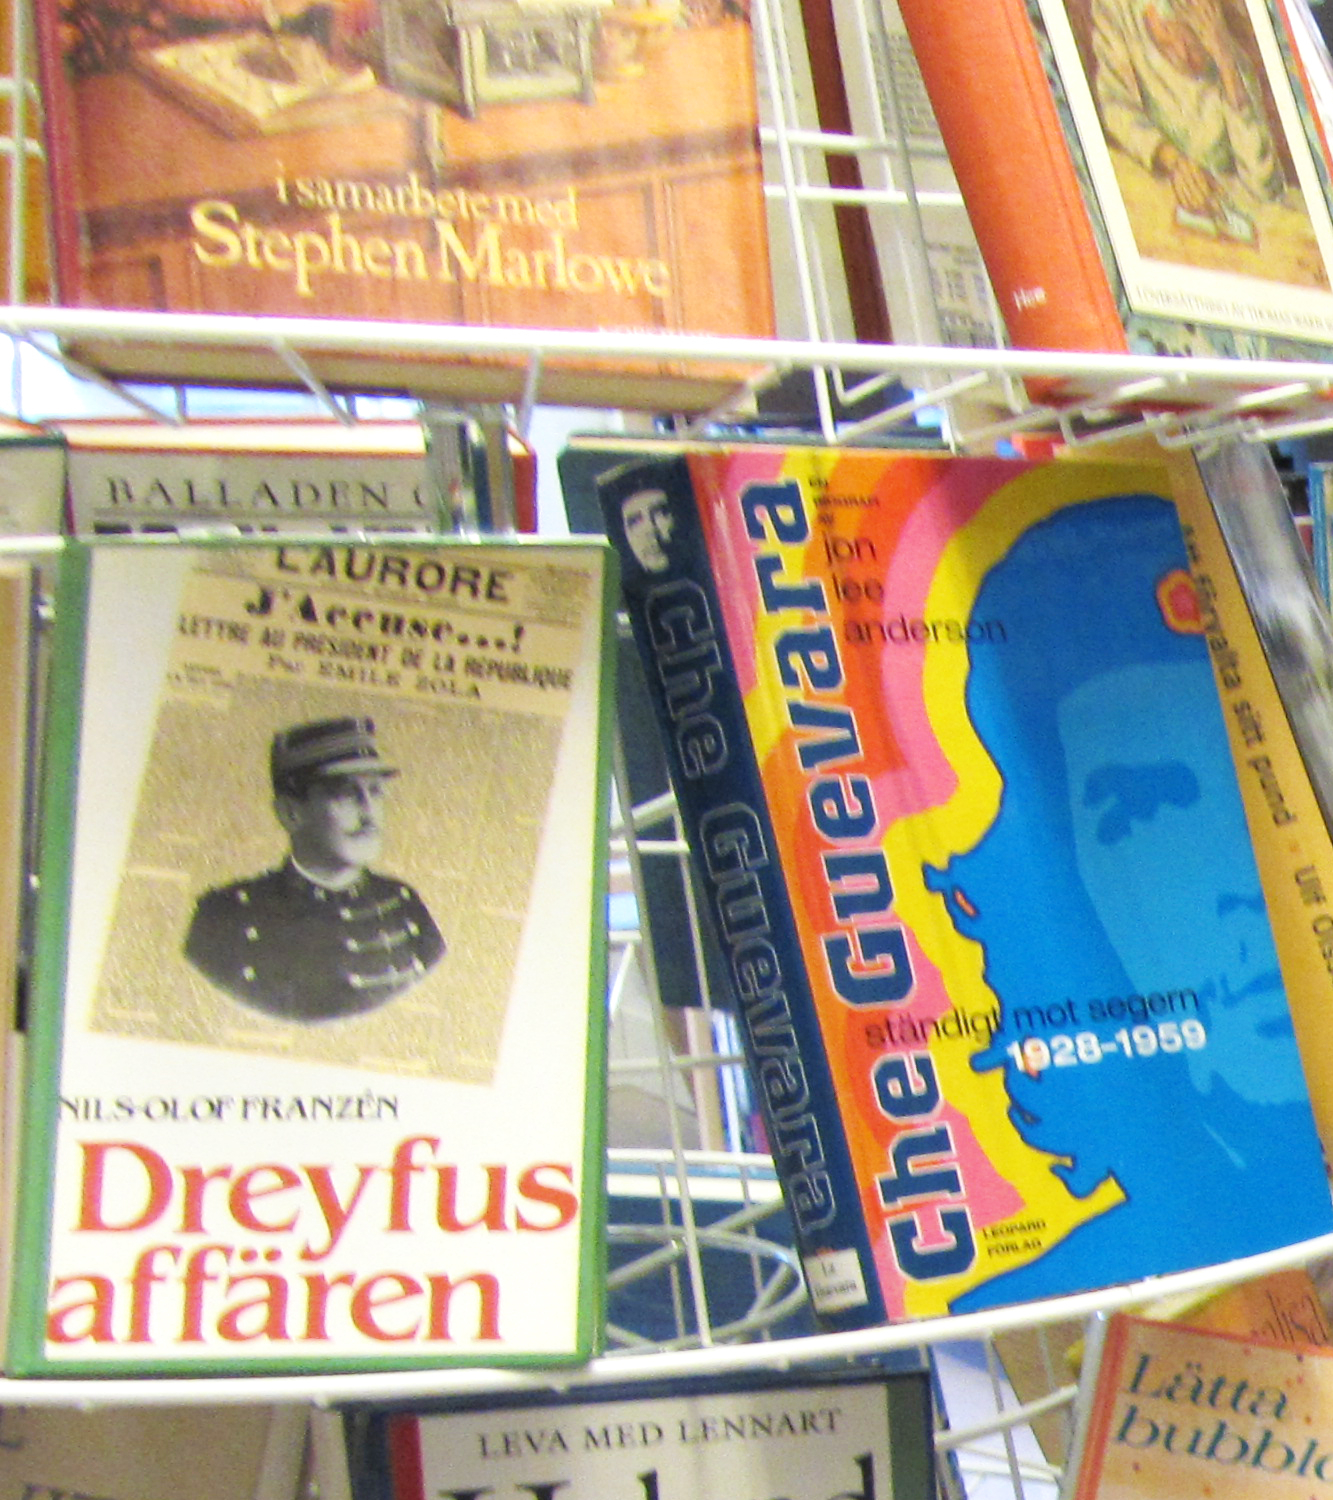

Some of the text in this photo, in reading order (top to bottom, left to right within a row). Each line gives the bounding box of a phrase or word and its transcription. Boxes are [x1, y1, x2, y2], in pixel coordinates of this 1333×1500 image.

[498, 186, 579, 229] med
[190, 200, 671, 297] Stephen Marlowe
[107, 477, 391, 510] BALLADEN
[823, 531, 877, 565] jon
[832, 573, 886, 602] lee
[179, 613, 250, 648] LETTRE
[433, 646, 455, 675] LA
[842, 612, 1008, 647] anderson
[1246, 753, 1298, 827] pund
[646, 578, 836, 1236] Che Guevara
[739, 477, 978, 1284] Che Guevara
[1293, 866, 1327, 917] Ulf
[864, 984, 1201, 1051] ständigt mot segern
[1005, 1018, 1207, 1075] 1928-1959
[242, 1089, 399, 1121] FRANZÉN
[71, 1134, 580, 1262] Dreyfus
[46, 1244, 503, 1346] affären
[1124, 1352, 1289, 1422] Lätta
[477, 1408, 844, 1460] LEVA MED LENNART
